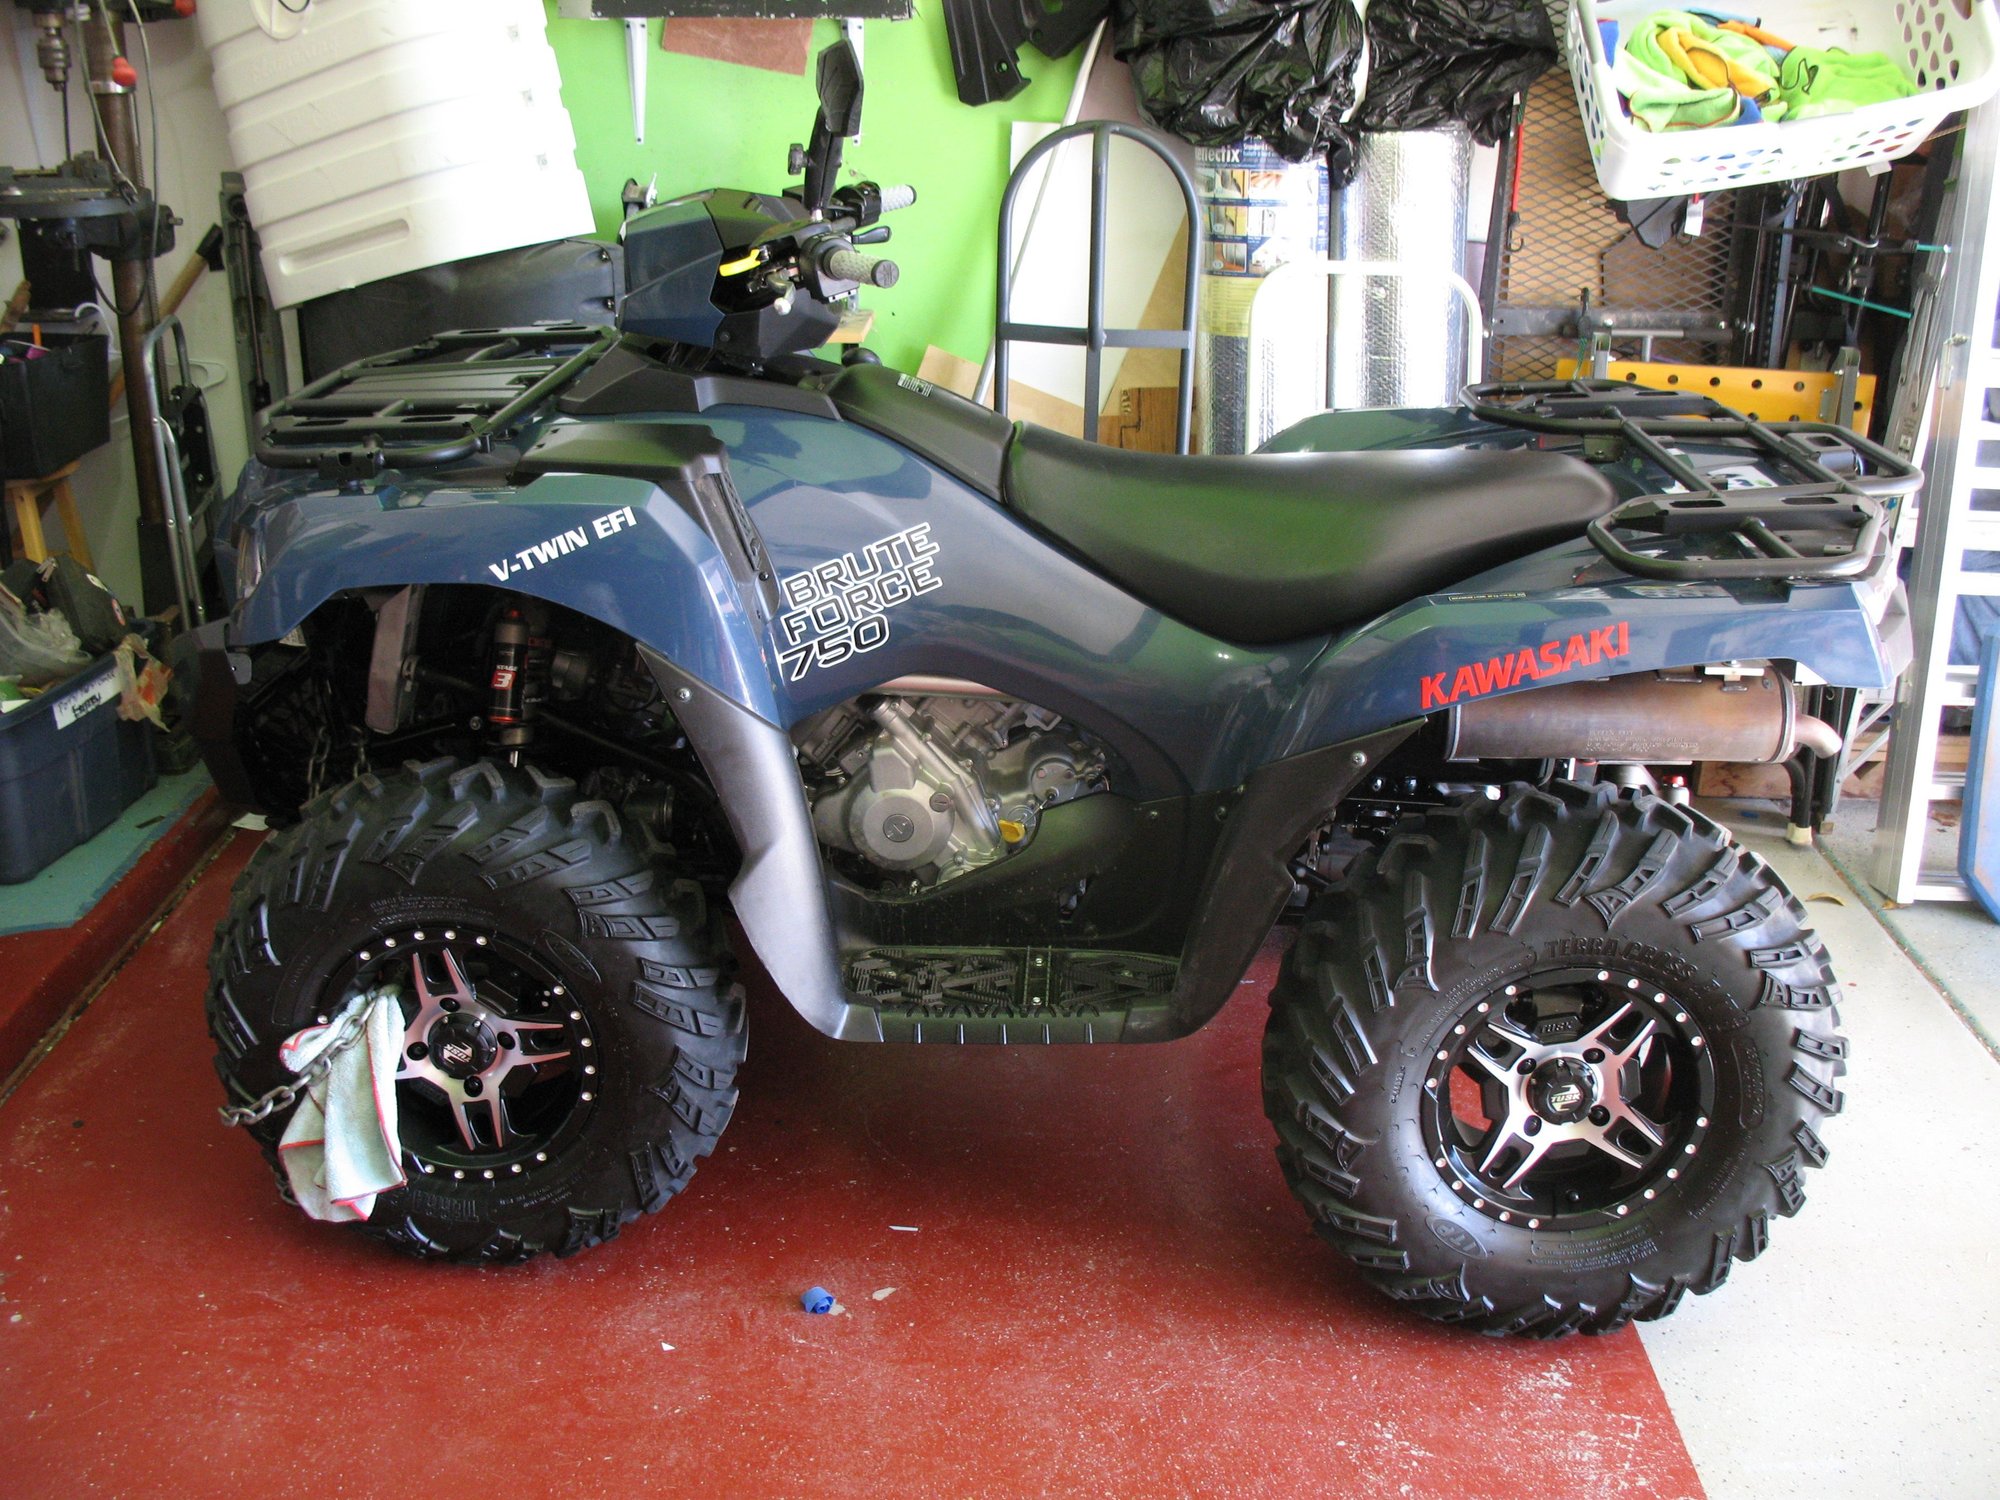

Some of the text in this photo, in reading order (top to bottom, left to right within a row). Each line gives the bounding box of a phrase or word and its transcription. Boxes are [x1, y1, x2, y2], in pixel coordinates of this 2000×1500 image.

[489, 506, 637, 582] V-TWIN EFI
[780, 522, 939, 611] BRUTE
[779, 558, 943, 647] FORCE
[494, 672, 513, 687] 3
[779, 614, 891, 682] 750
[1420, 621, 1630, 710] KAWASAKI
[1544, 937, 1619, 958] TERRA
[1551, 1093, 1581, 1103] TUSK
